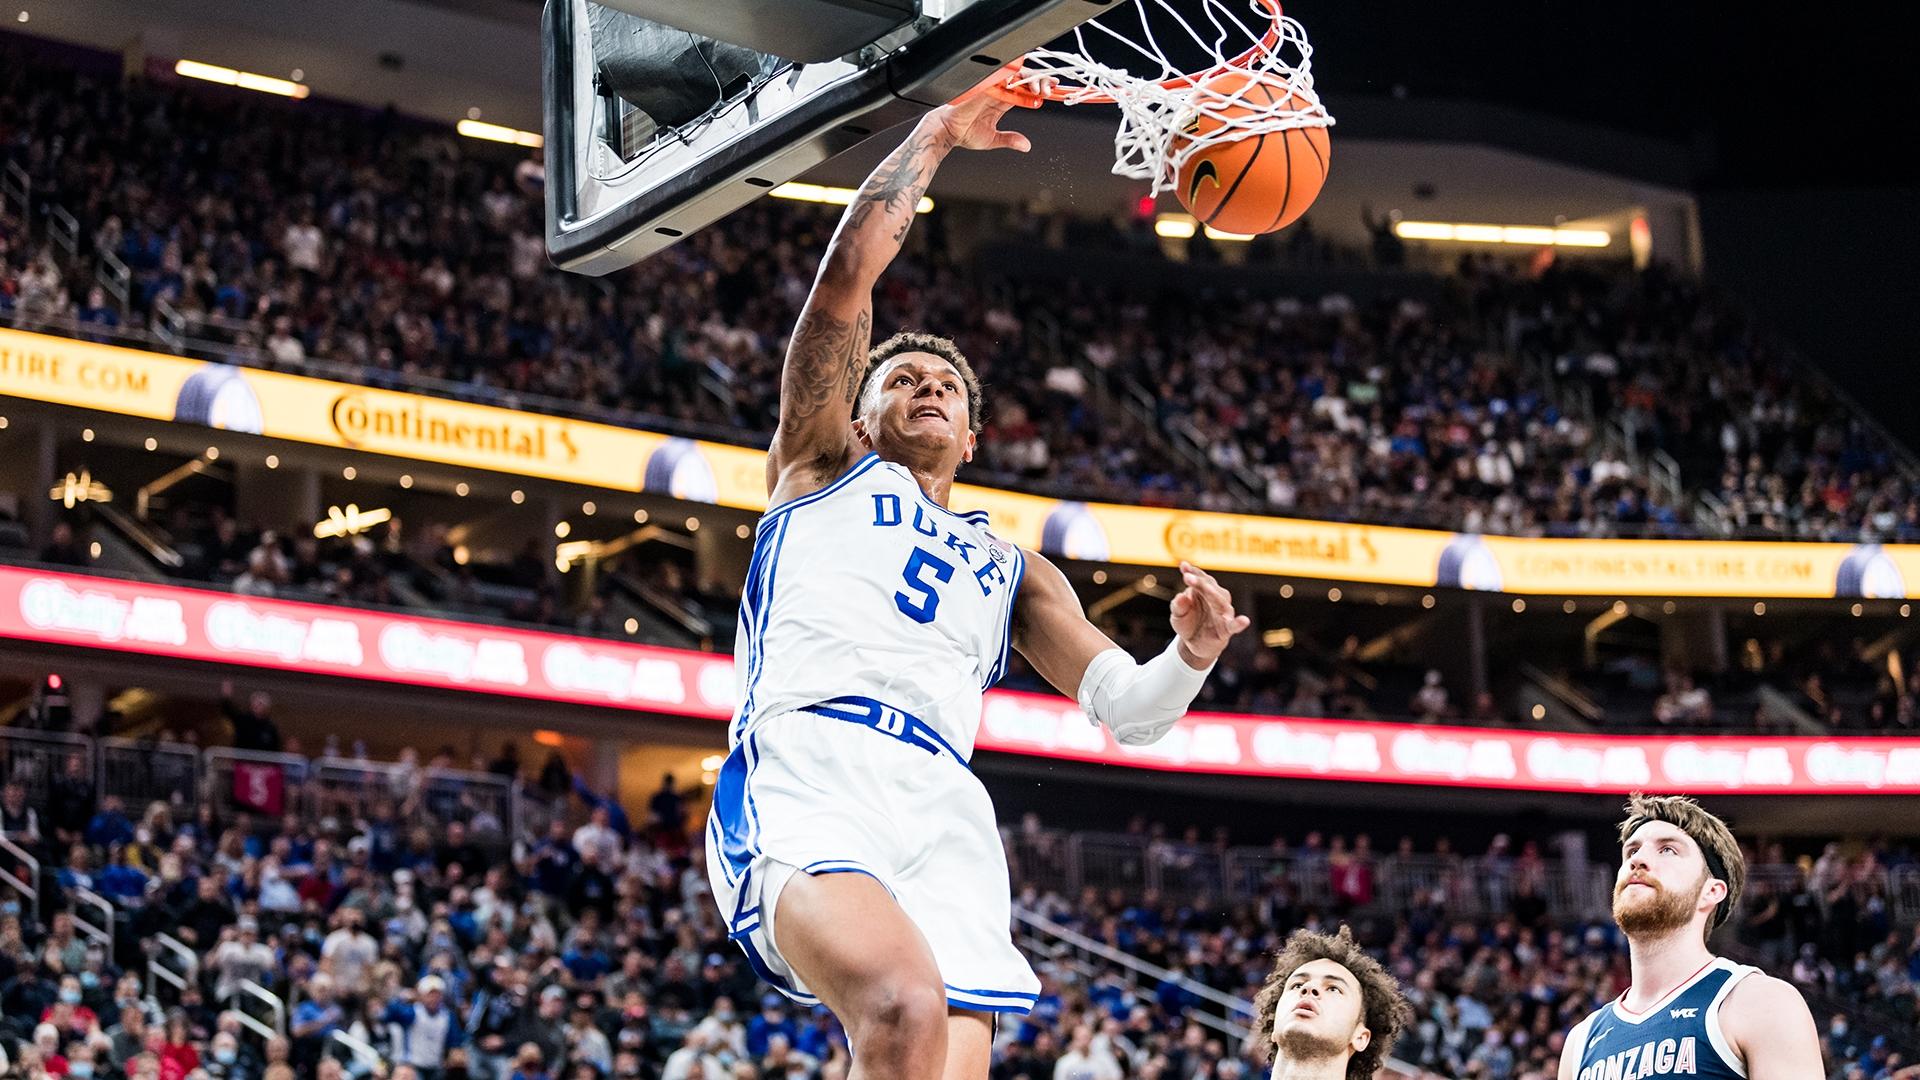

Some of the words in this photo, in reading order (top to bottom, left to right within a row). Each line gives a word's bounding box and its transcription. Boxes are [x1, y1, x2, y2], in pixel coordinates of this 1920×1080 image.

[331, 393, 546, 458] Continental
[871, 493, 1006, 598] DUKE
[1163, 517, 1350, 562] Continental
[894, 546, 955, 624] 5
[875, 704, 905, 736] D
[1669, 1007, 1699, 1020] WCC
